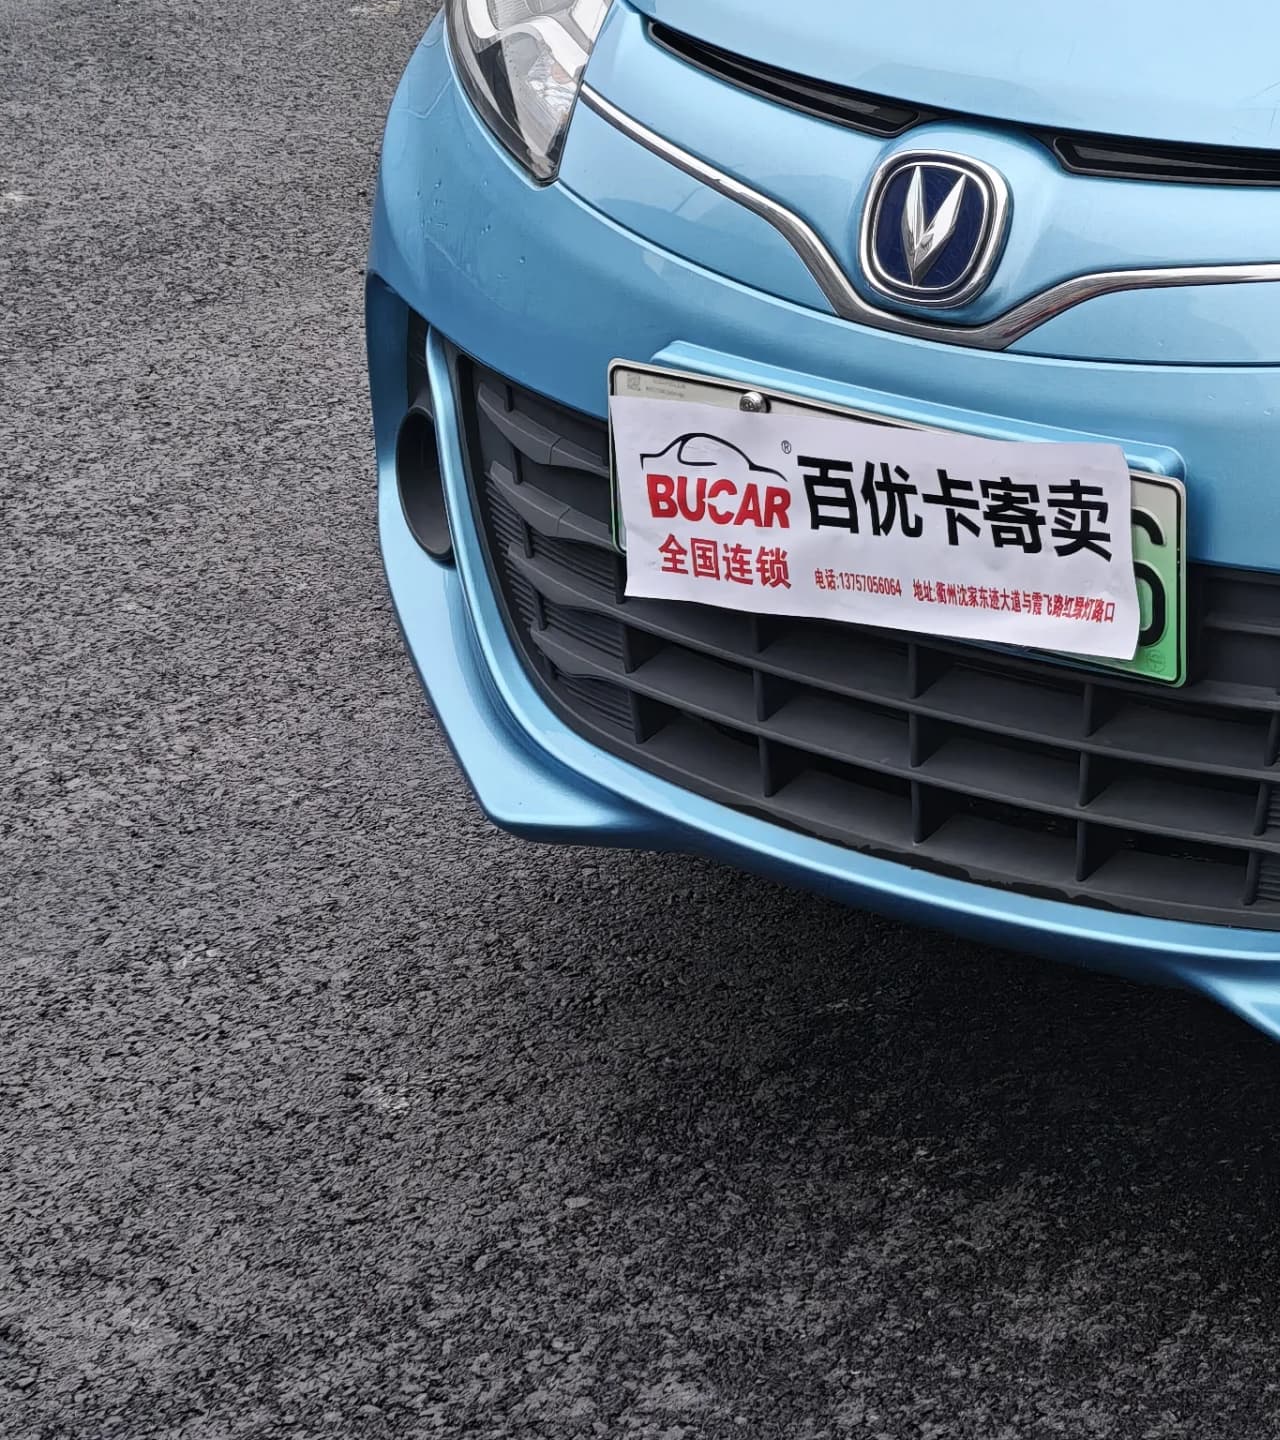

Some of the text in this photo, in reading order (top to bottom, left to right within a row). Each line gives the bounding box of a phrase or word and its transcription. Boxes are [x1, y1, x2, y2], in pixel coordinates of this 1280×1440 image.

[646, 473, 792, 529] BUCAR
[797, 455, 1112, 563] 百优卡寄卖
[658, 533, 792, 590] 全国连锁
[814, 567, 902, 597] 电话:13757056064
